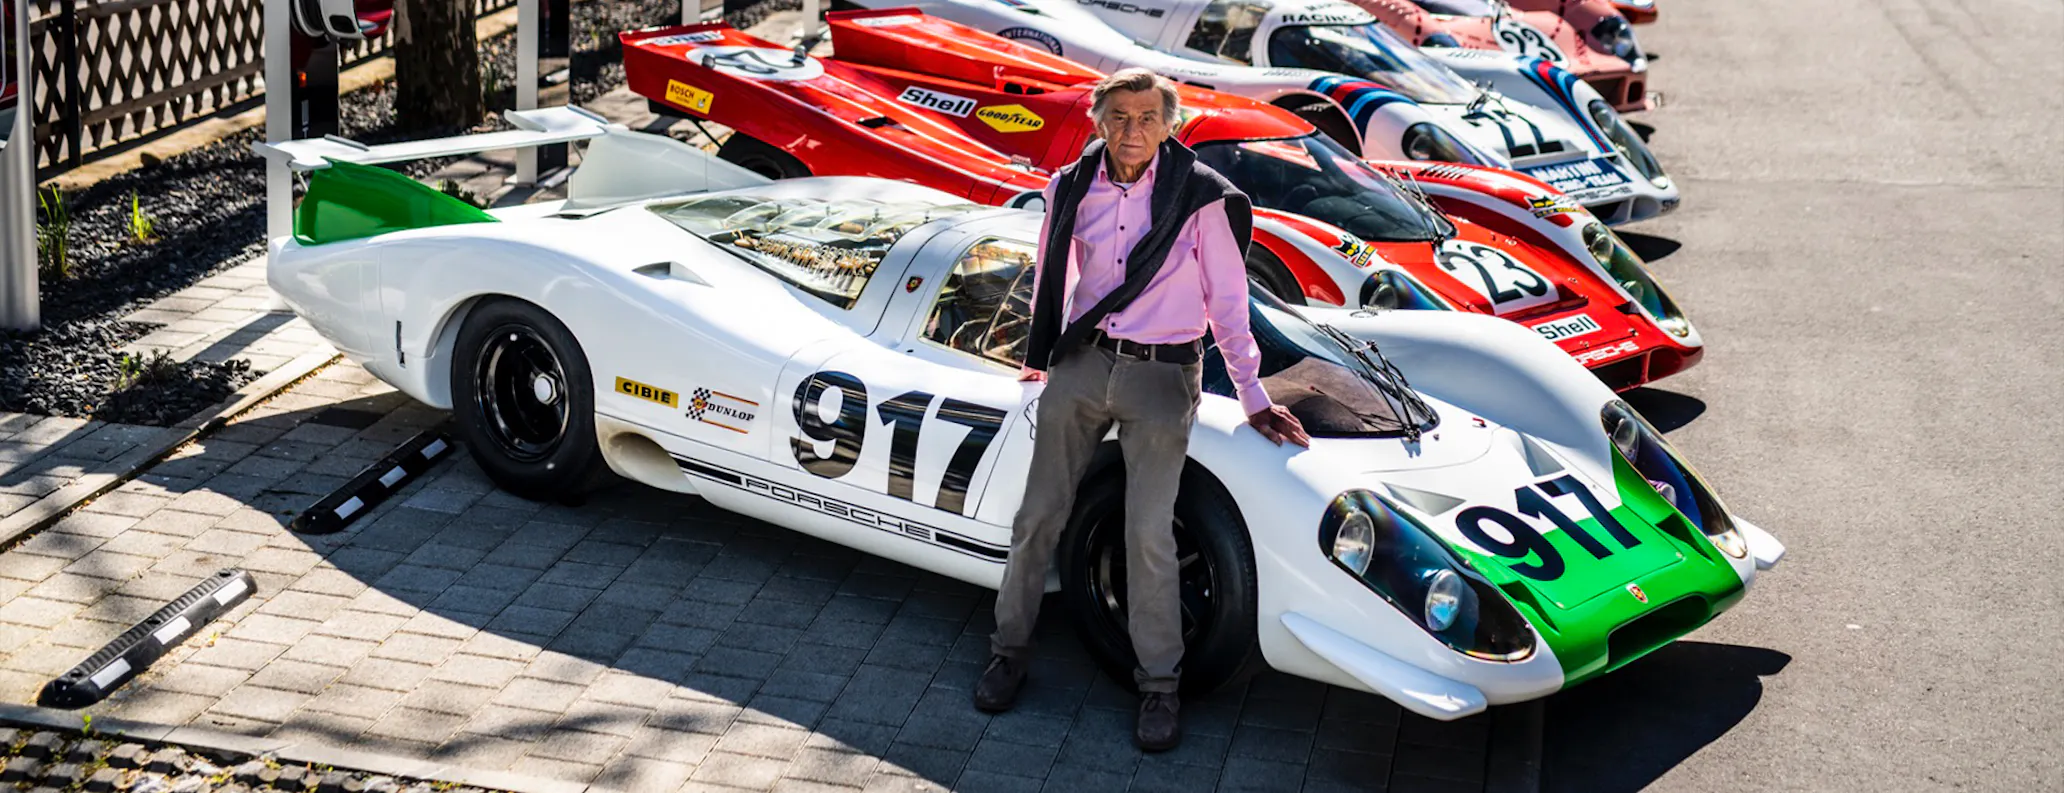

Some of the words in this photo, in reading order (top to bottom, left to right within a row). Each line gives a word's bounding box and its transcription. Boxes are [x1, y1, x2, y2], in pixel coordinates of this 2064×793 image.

[1077, 0, 1165, 18] ORSCHE
[670, 84, 695, 100] BOSCH
[902, 88, 974, 115] Shell
[1439, 245, 1549, 305] 23
[1536, 315, 1597, 340] Shell
[707, 402, 755, 422] DUNLOP
[789, 370, 1008, 517] 917
[745, 478, 931, 540] PORSCHE
[1455, 474, 1643, 582] 917
